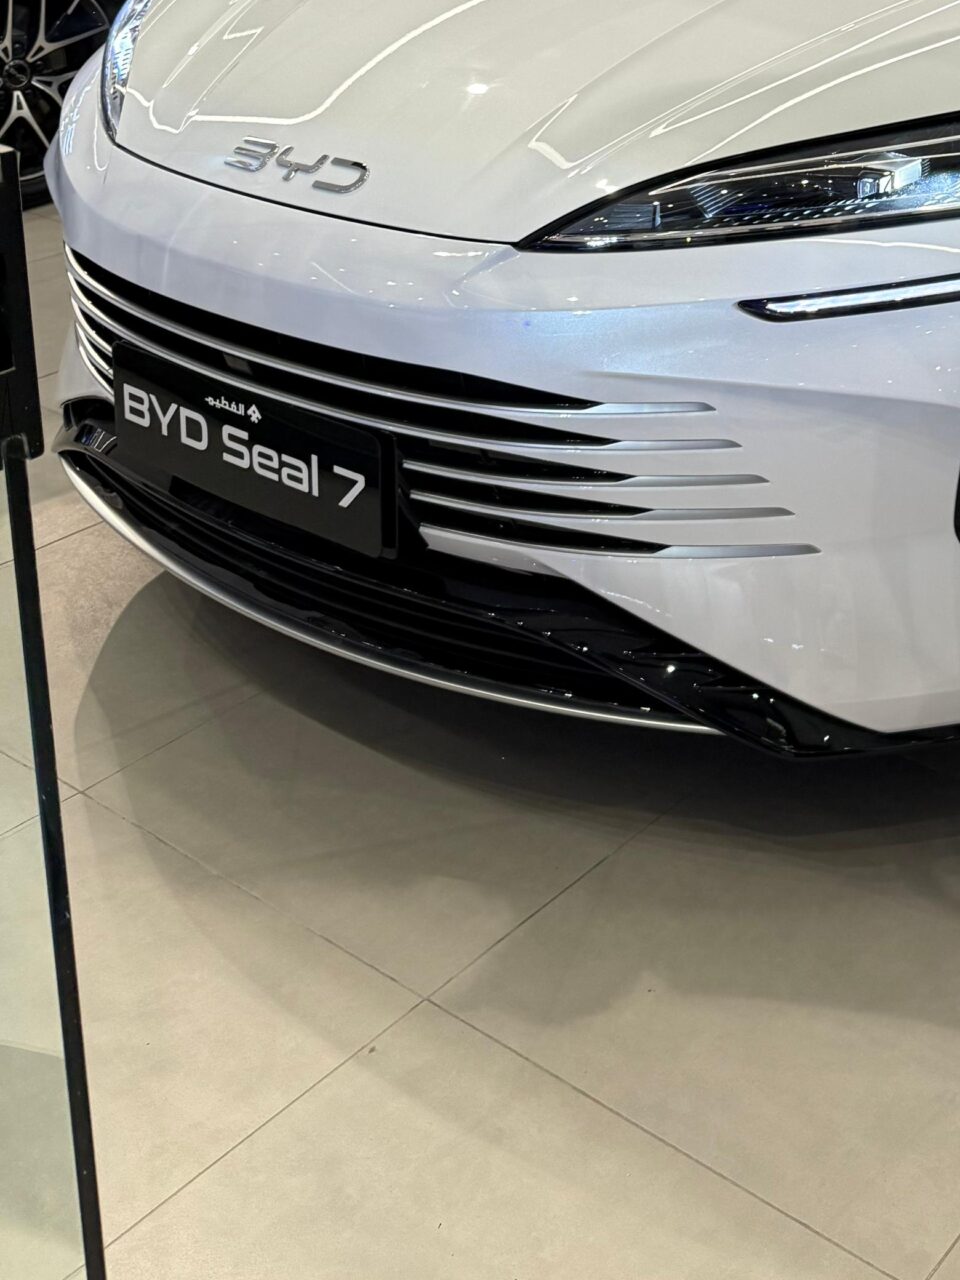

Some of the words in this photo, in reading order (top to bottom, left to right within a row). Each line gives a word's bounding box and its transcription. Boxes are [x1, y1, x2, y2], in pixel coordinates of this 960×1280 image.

[224, 135, 371, 194] BYD
[204, 395, 245, 417] الفطيم
[122, 382, 209, 451] BYD
[221, 423, 320, 498] Seal
[332, 464, 366, 509] 7
